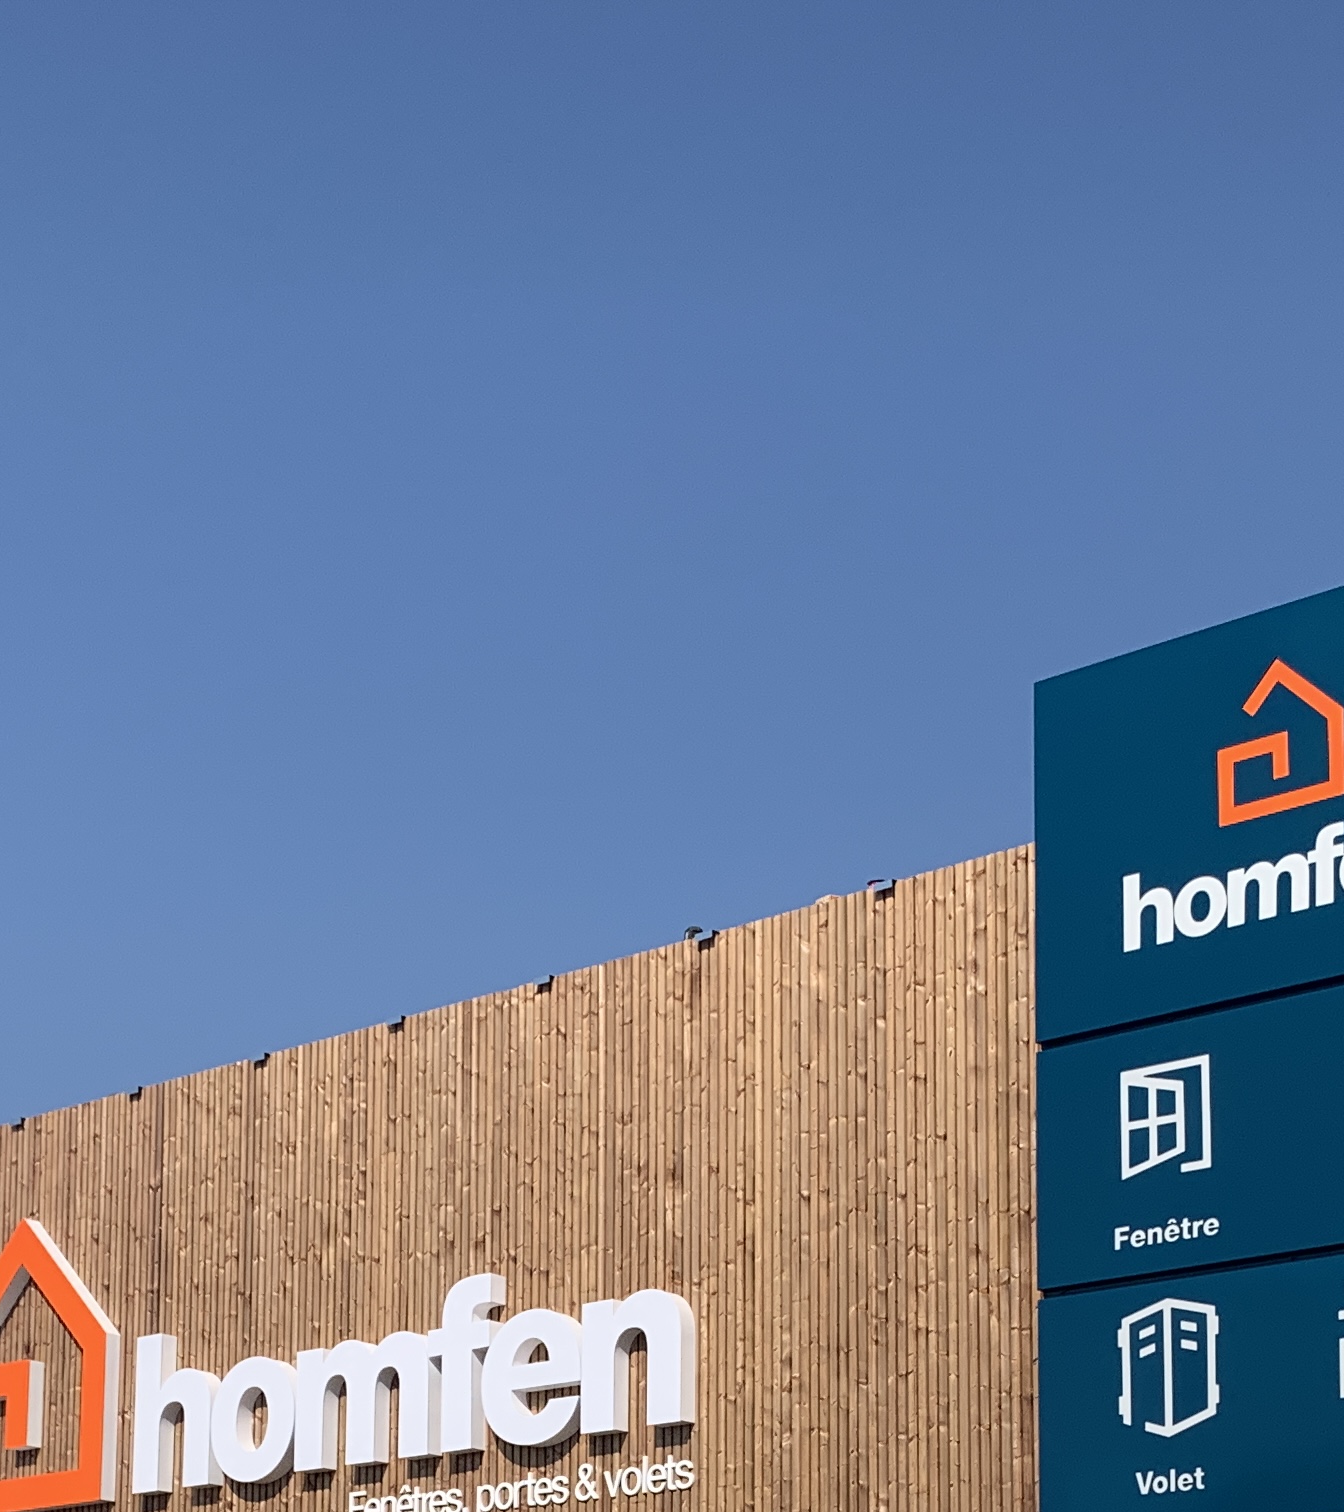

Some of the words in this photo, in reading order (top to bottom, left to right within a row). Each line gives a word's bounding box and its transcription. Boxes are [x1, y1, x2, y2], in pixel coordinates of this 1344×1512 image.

[1113, 1216, 1220, 1251] Fenêtre
[132, 1272, 696, 1495] homfen
[574, 1463, 599, 1503] &
[604, 1454, 696, 1499] volets
[1135, 1467, 1205, 1495] Volet
